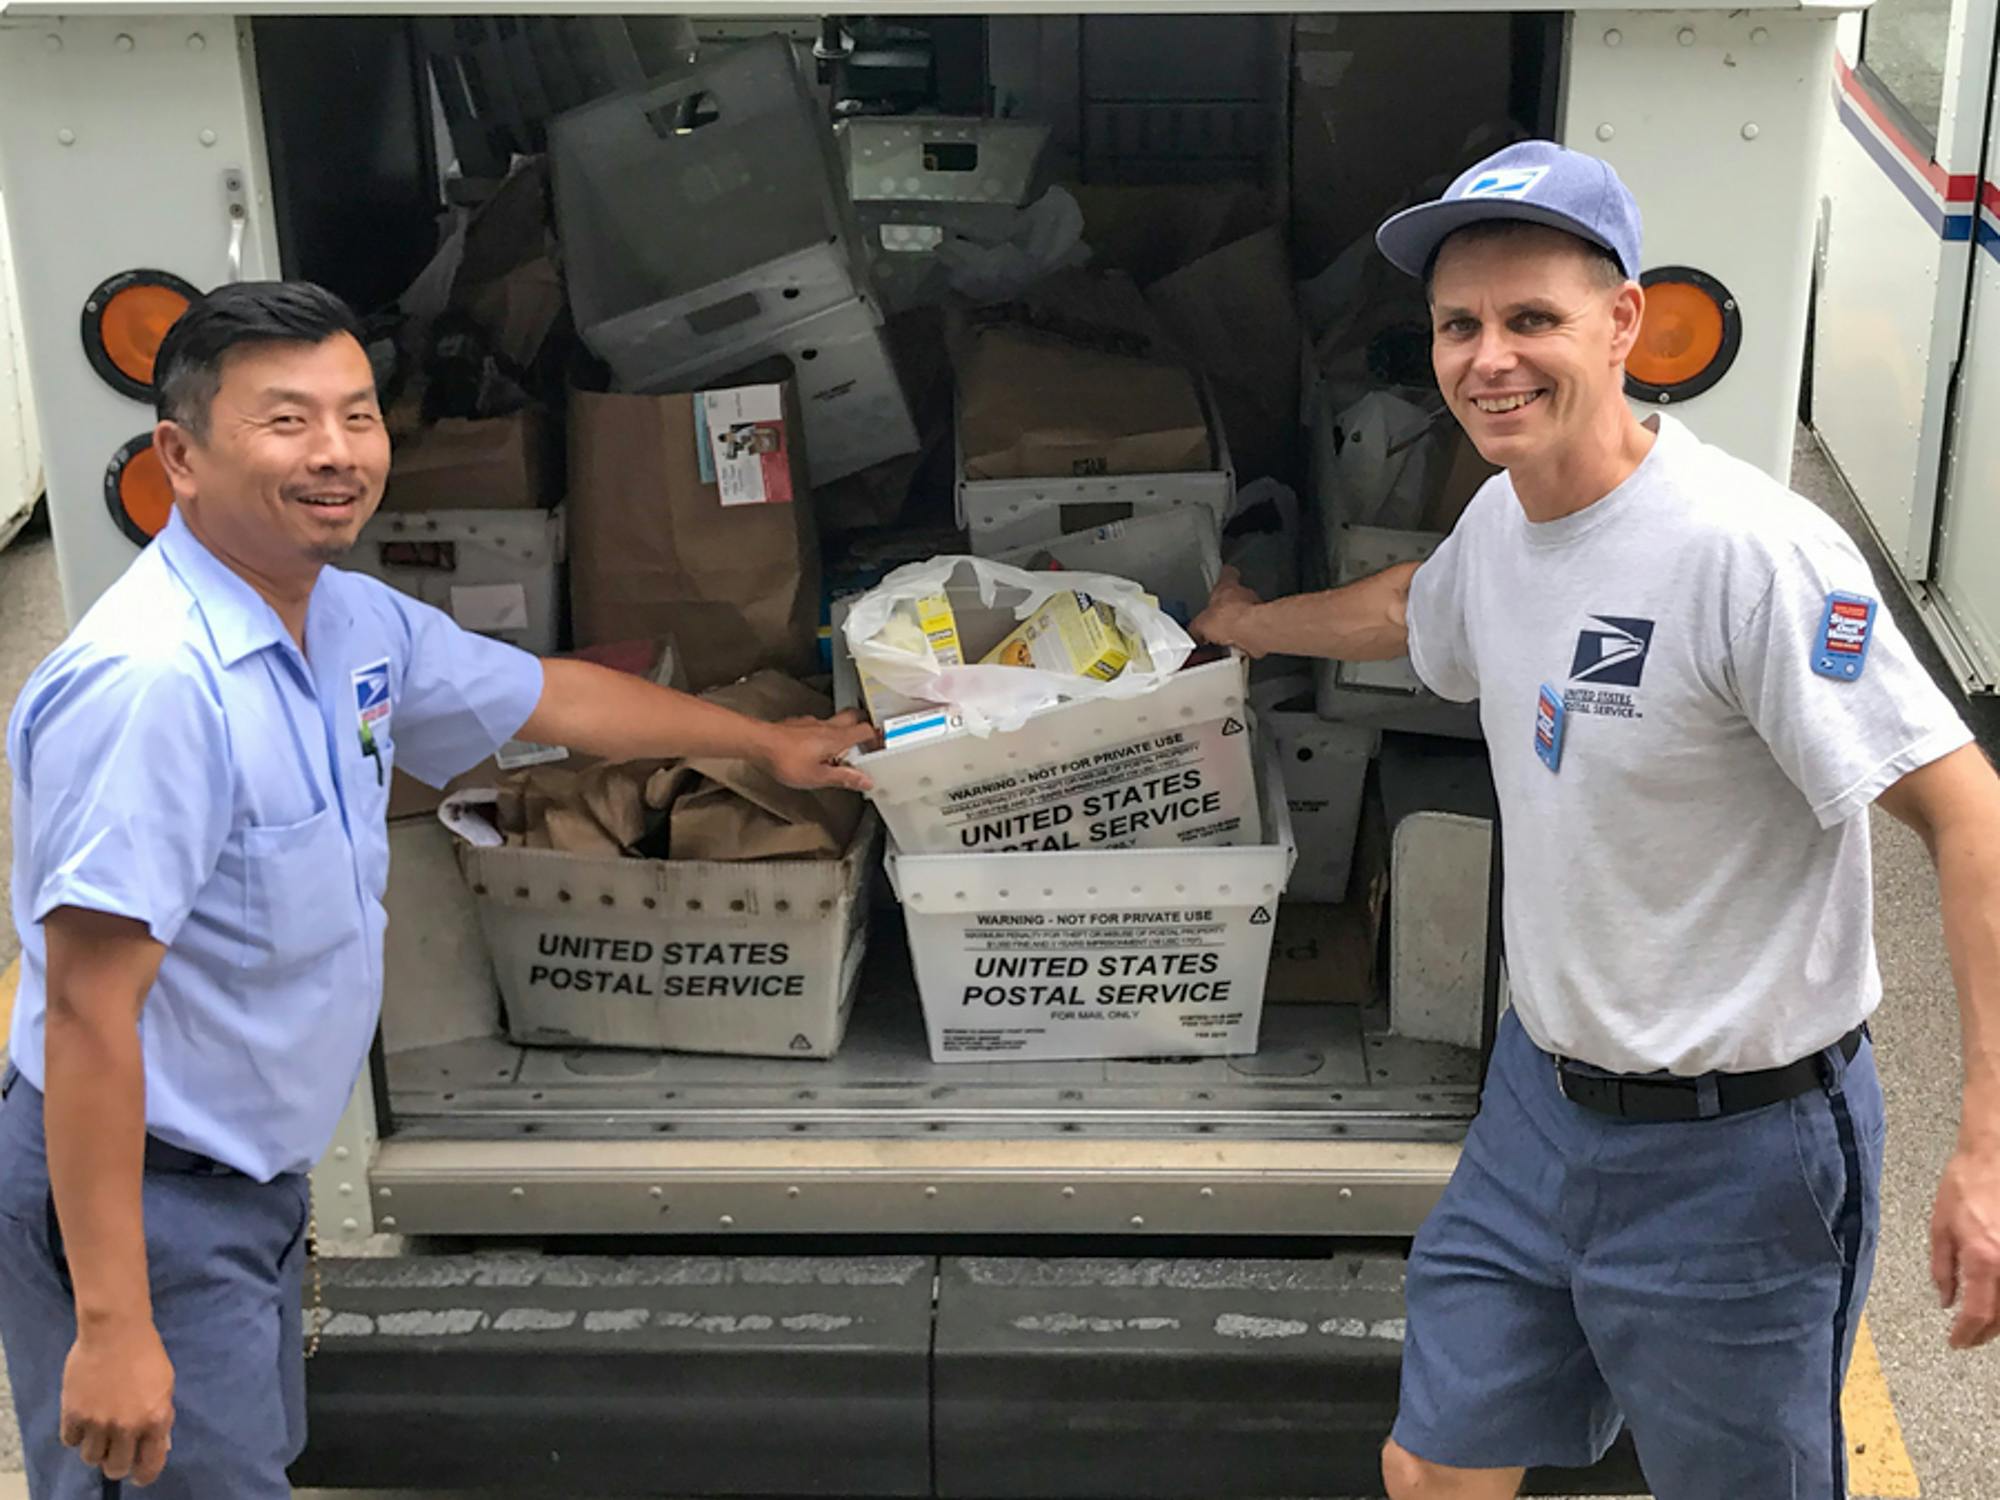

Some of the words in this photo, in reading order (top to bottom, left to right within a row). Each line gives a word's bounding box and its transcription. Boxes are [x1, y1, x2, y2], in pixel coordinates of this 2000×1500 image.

[949, 776, 1017, 801] WARNING
[1028, 766, 1058, 782] NOT
[1061, 757, 1091, 774] FOR
[1094, 742, 1151, 765] PRIVATE
[1155, 733, 1184, 748] USE
[961, 804, 1073, 847] UNITED
[1083, 769, 1202, 817] STATES
[1089, 790, 1221, 843] SERVICE
[976, 914, 1045, 926] WARNING
[1057, 914, 1086, 925] NOT
[1090, 912, 1119, 925] FOR
[1122, 911, 1181, 923] PRIVATE
[1184, 910, 1213, 922] USE
[538, 933, 653, 963] UNITED
[661, 943, 789, 966] STATES
[975, 957, 1089, 978] UNITED
[1097, 953, 1219, 977] STATES
[529, 965, 653, 995] POSTAL
[663, 975, 805, 997] SERVICE
[962, 985, 1086, 1007] POSTAL
[1096, 980, 1232, 1005] SERVICE
[1050, 1011, 1076, 1020] FOR
[1078, 1011, 1104, 1020] MAIL
[1107, 1010, 1140, 1020] ONLY
